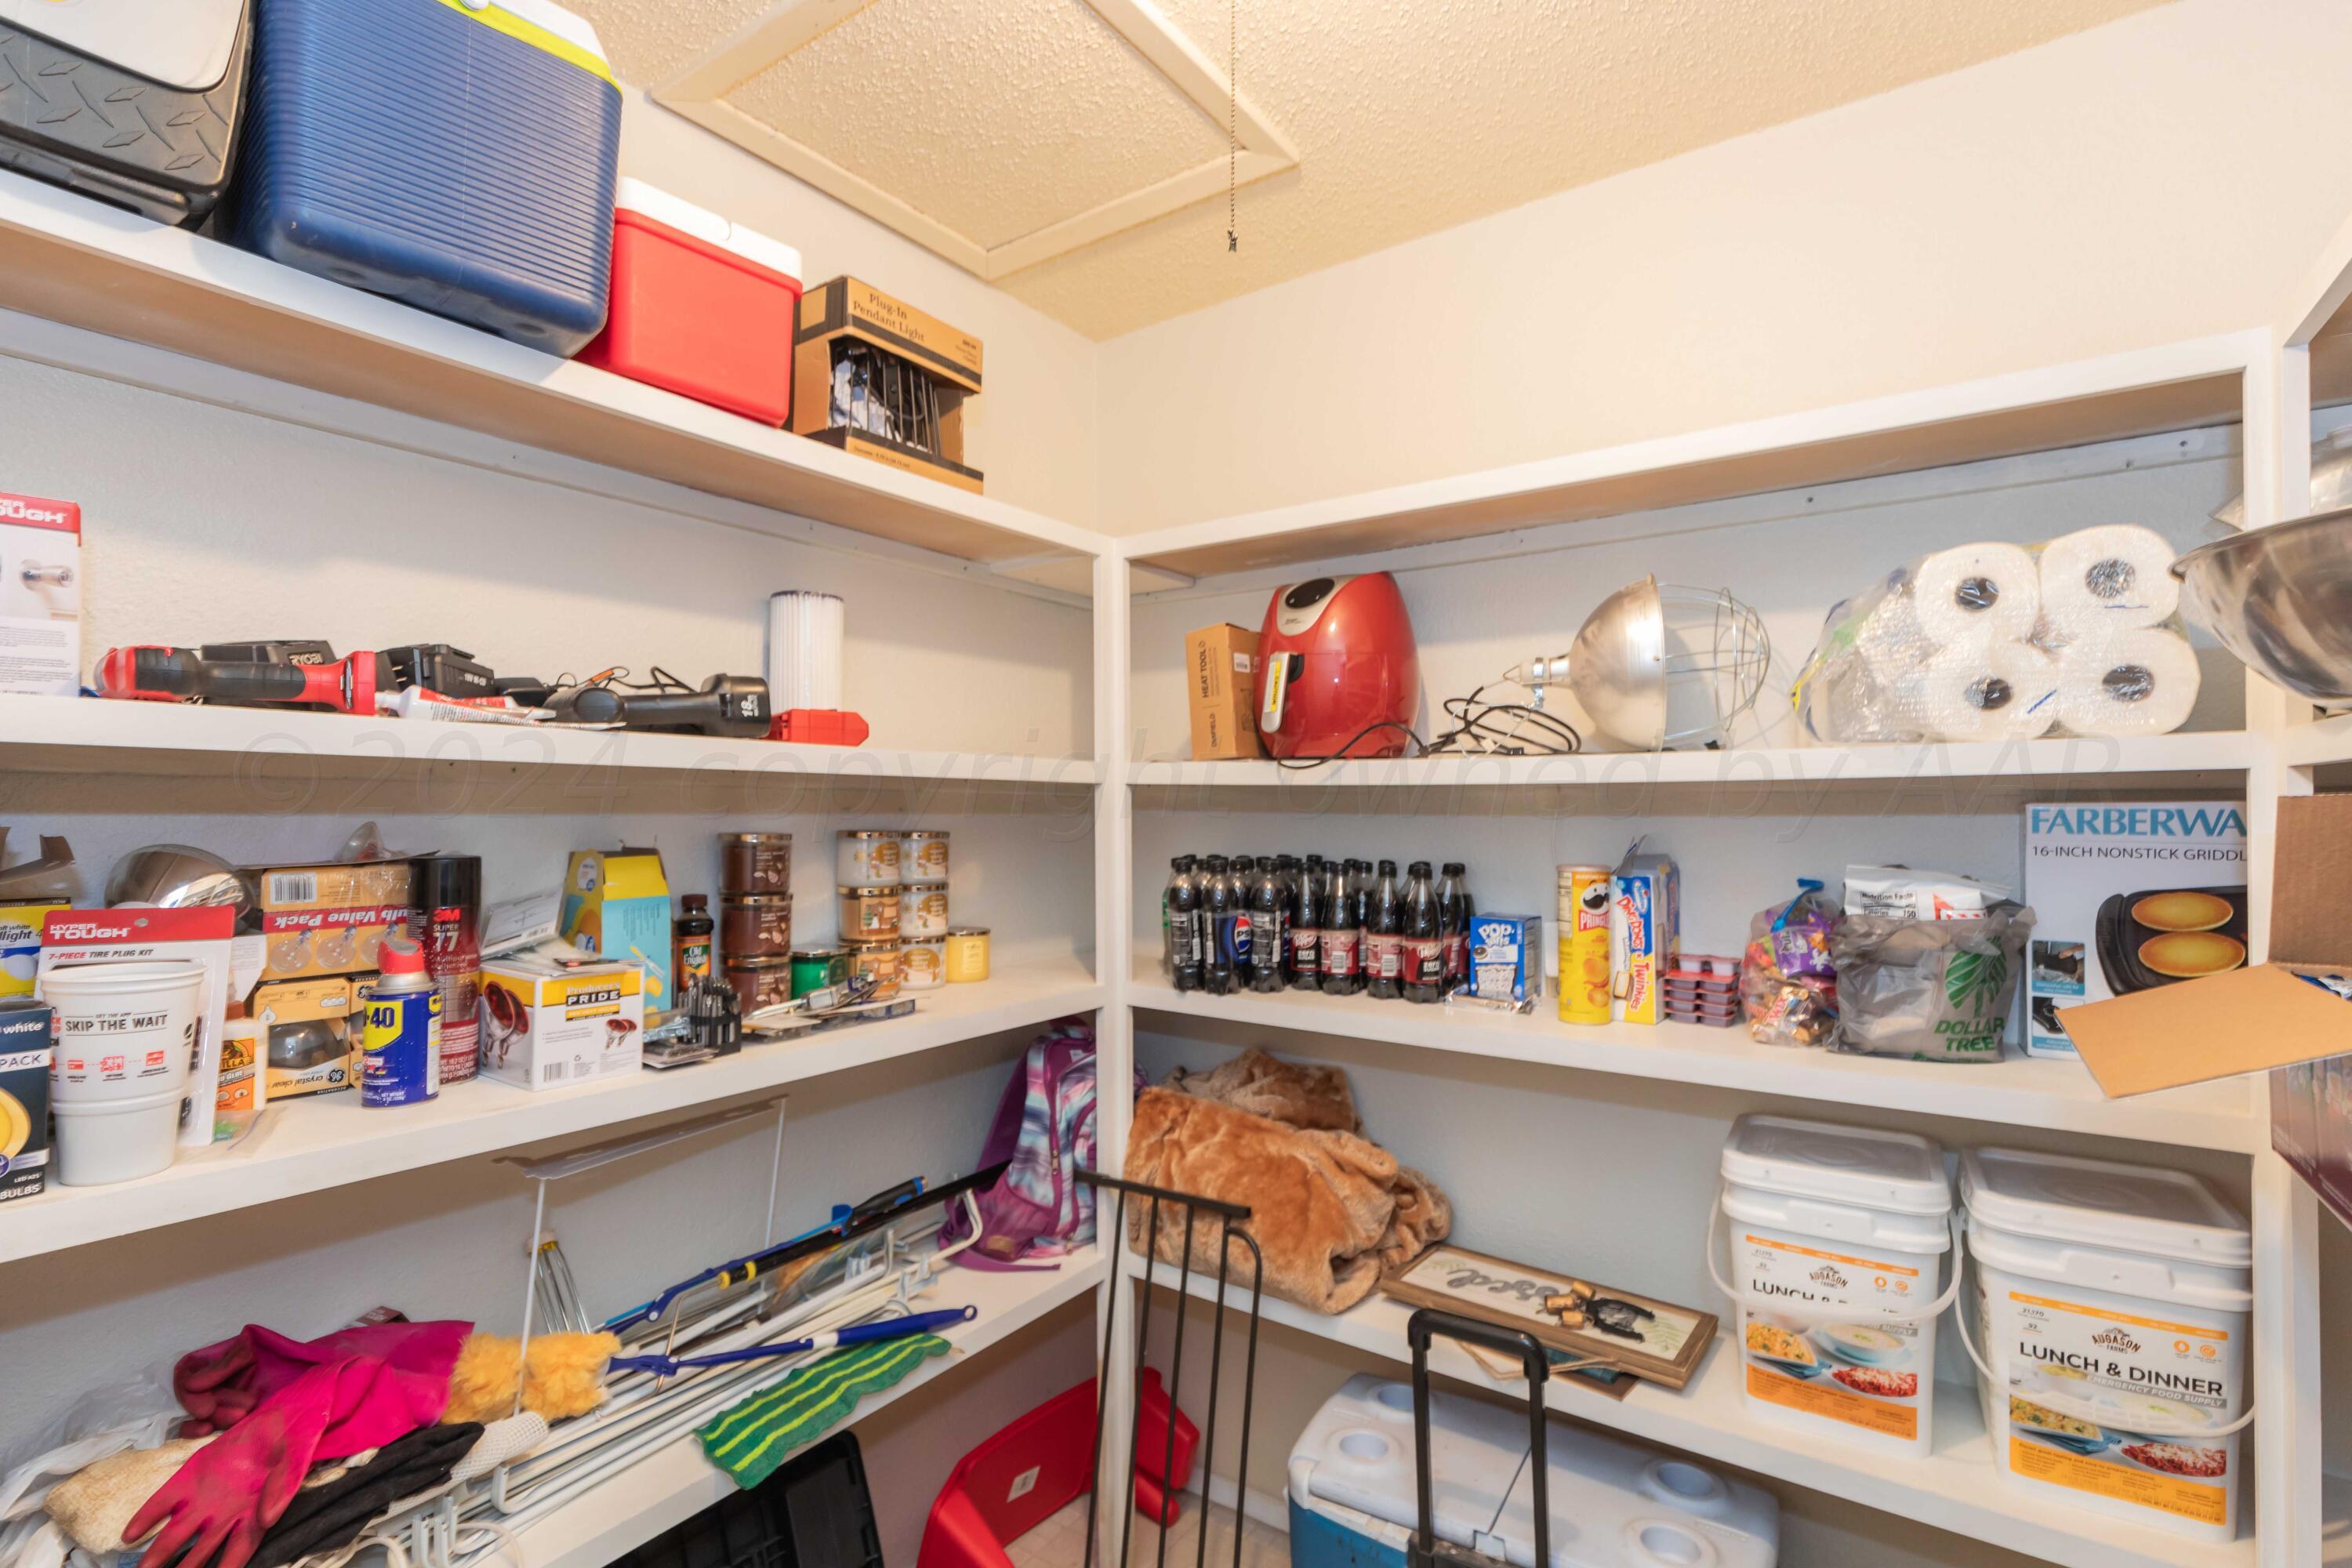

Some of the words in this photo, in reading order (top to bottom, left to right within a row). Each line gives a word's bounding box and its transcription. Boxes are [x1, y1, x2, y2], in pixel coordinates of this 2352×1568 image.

[869, 292, 907, 319] Plug-In
[854, 299, 895, 328] Pendant
[898, 322, 924, 342] Light
[289, 652, 323, 665] RYOBI
[1199, 649, 1208, 673] TOOL
[1200, 674, 1210, 699] HEAT
[2032, 846, 2092, 858] 16-INCH
[2097, 847, 2180, 860] NONSTICK
[274, 914, 323, 928] Pack
[327, 910, 376, 924] Value
[433, 908, 461, 922] 3M
[49, 927, 129, 940] TOUGH
[432, 931, 459, 952] 77
[689, 946, 702, 957] Old
[683, 953, 708, 967] English
[568, 991, 619, 1005] PRIDE
[3, 1021, 45, 1034] white
[65, 1020, 94, 1032] SKIP
[97, 1018, 127, 1031] THE
[132, 1014, 168, 1028] WAIT
[1934, 1017, 2005, 1035] DOLLAR
[1946, 1036, 1995, 1052] TREE
[0, 1054, 42, 1068] PACK
[271, 1080, 293, 1089] clear
[295, 1075, 324, 1087] crystal
[0, 1182, 42, 1200] BULBS
[1809, 1271, 1849, 1288] AUGASON
[2091, 1334, 2141, 1352] AUGASON
[2106, 1344, 2129, 1355] FARMS
[2019, 1341, 2100, 1373] LUNCH
[2106, 1362, 2122, 1378] &
[2129, 1366, 2223, 1397] DINNER
[2086, 1375, 2150, 1394] EMERGENCY
[2151, 1387, 2183, 1401] FOOD
[2183, 1394, 2224, 1407] SUPPLY
